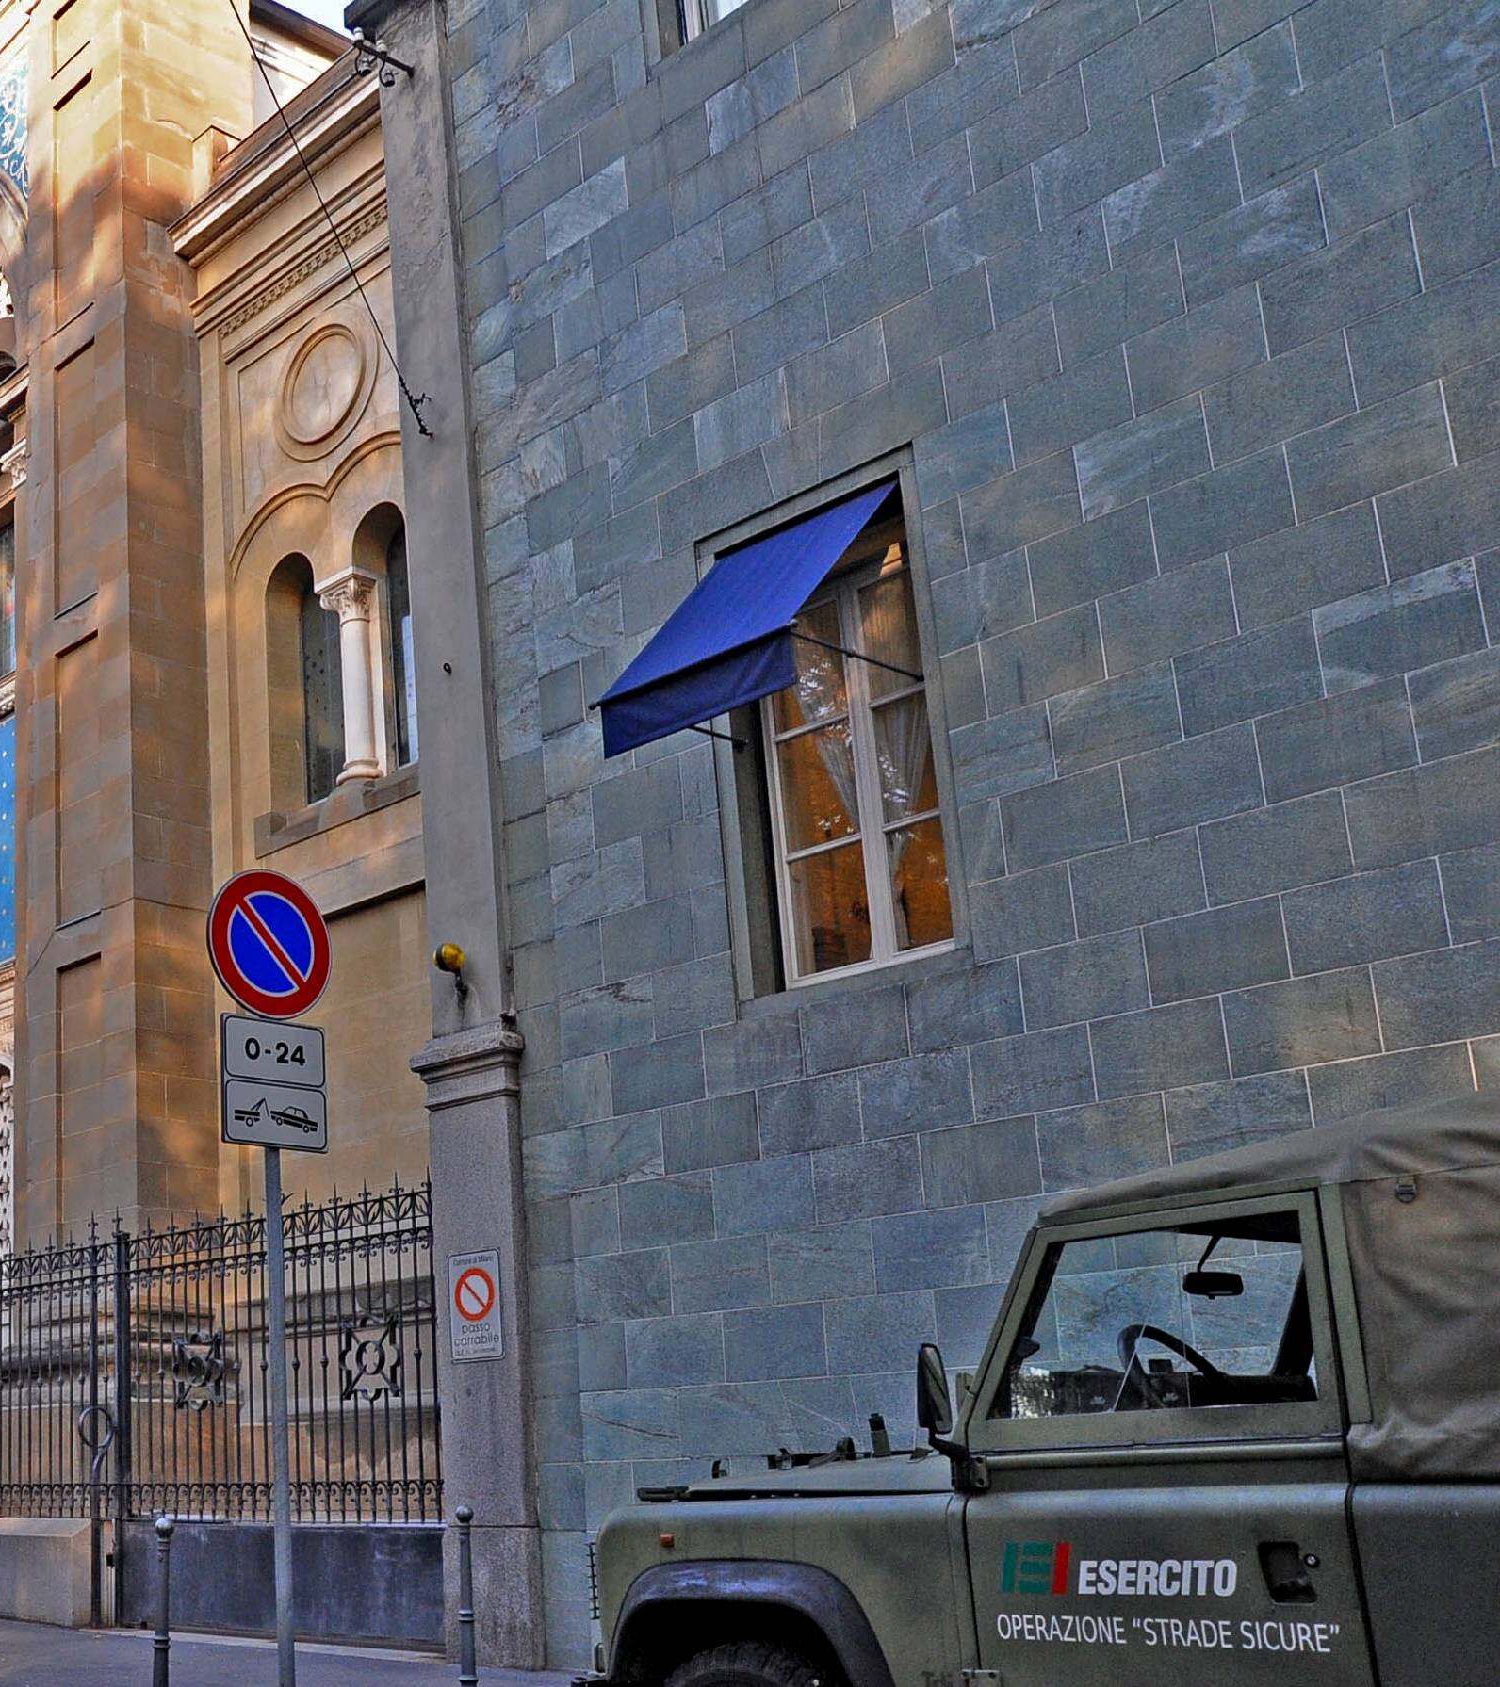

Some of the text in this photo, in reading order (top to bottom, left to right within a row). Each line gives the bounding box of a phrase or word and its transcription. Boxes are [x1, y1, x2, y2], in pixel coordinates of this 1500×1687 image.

[462, 1322, 490, 1334] passo
[454, 1333, 500, 1347] carrabile
[1078, 1559, 1238, 1598] ESERCITO
[997, 1613, 1127, 1645] OPERAZIONE
